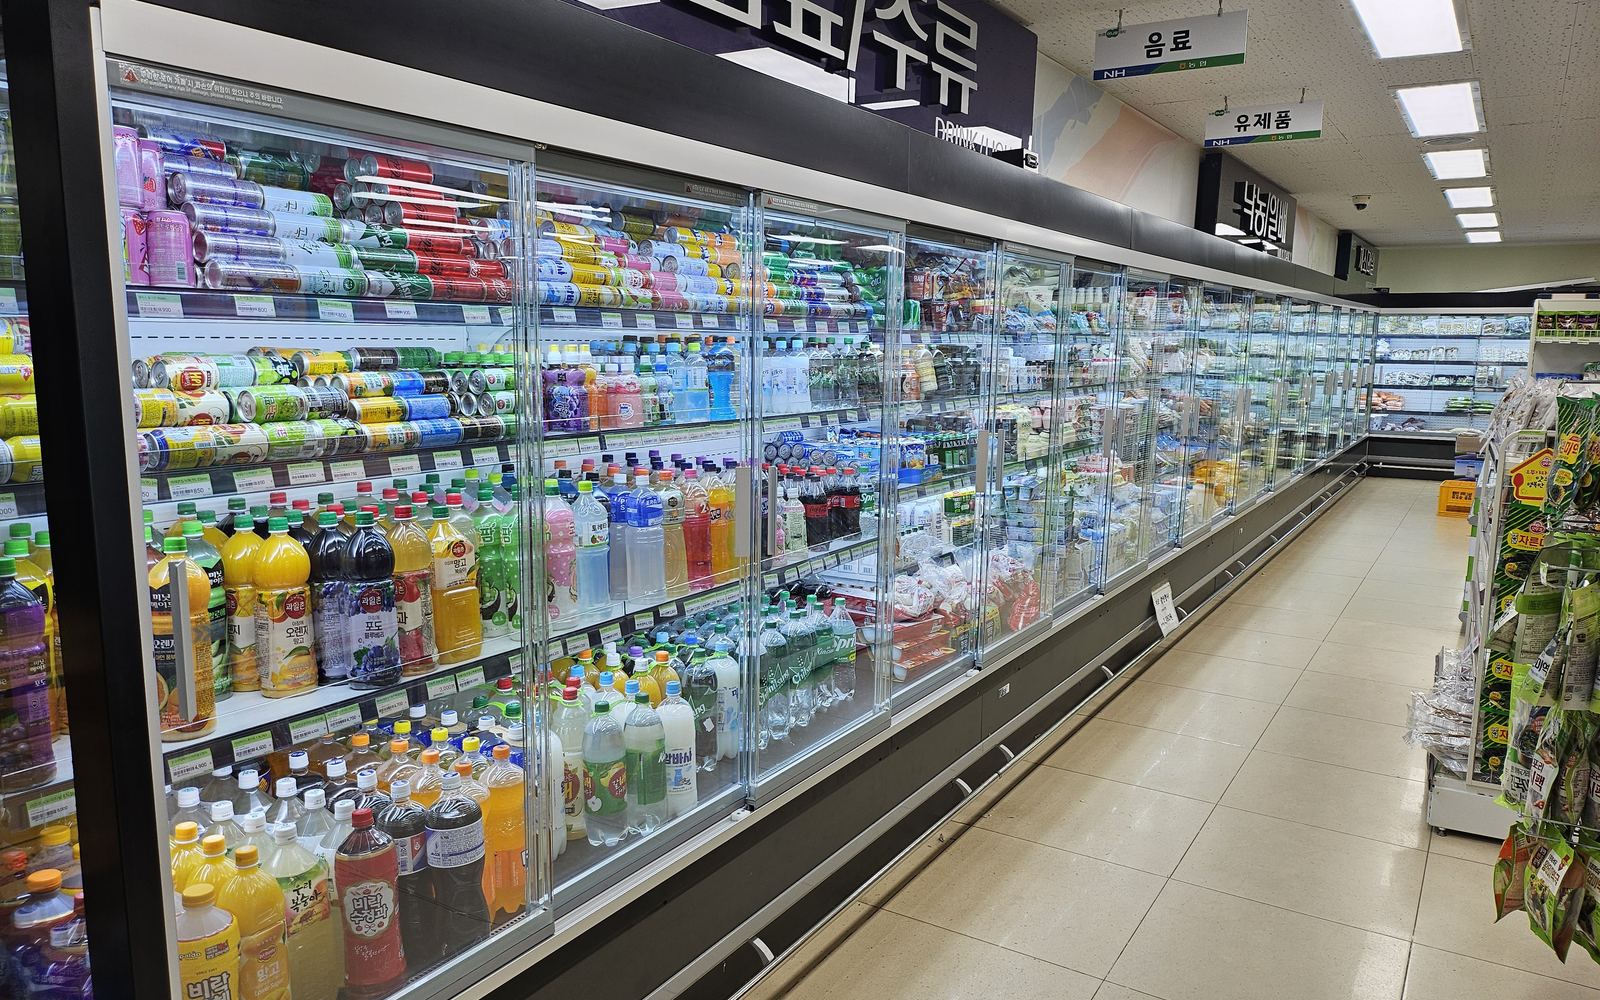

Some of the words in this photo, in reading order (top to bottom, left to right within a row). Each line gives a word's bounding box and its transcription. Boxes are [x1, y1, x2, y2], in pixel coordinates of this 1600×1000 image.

[1144, 30, 1192, 58] 음료
[1104, 68, 1126, 78] NH
[1234, 110, 1292, 132] 유제품
[454, 558, 466, 568] 망고
[286, 627, 309, 638] 오렌지
[366, 621, 382, 631] 포도
[1534, 658, 1550, 676] 미역
[292, 880, 312, 895] 우리
[290, 890, 321, 913] 복숭아
[352, 893, 382, 912] 비락
[350, 905, 388, 925] 수정과
[256, 964, 279, 982] 망고
[187, 970, 230, 999] 비락
